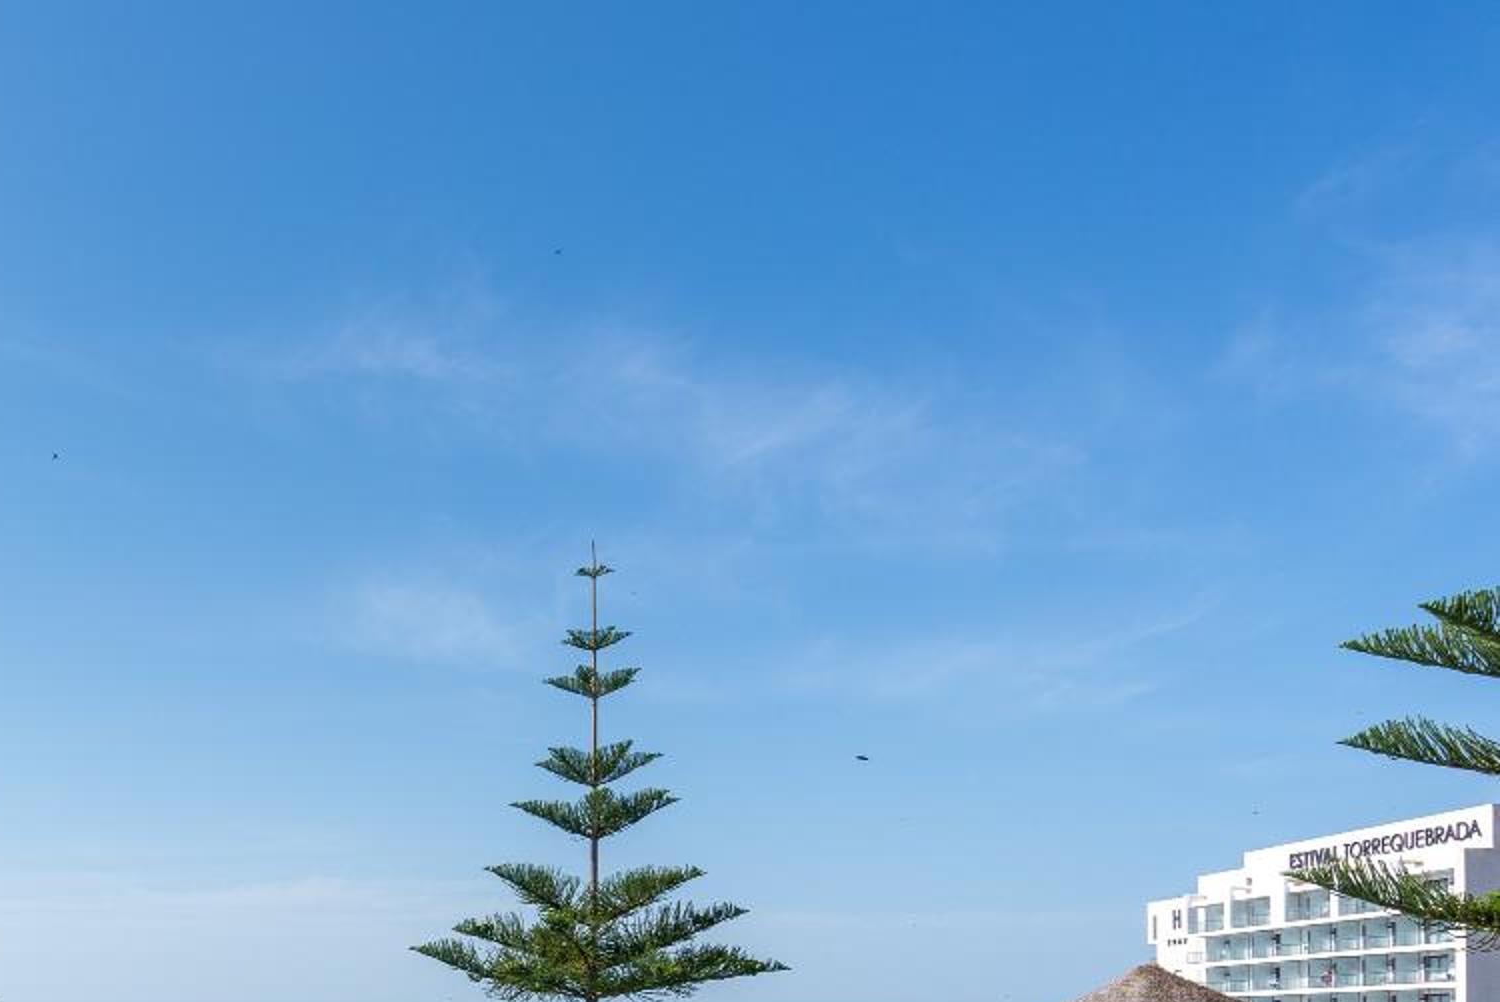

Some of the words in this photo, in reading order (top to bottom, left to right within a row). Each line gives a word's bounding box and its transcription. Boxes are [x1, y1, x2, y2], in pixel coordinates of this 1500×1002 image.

[1289, 845, 1338, 869] ESTIVAL
[1343, 819, 1482, 859] TORREQUEBRADA
[1172, 909, 1182, 930] H
